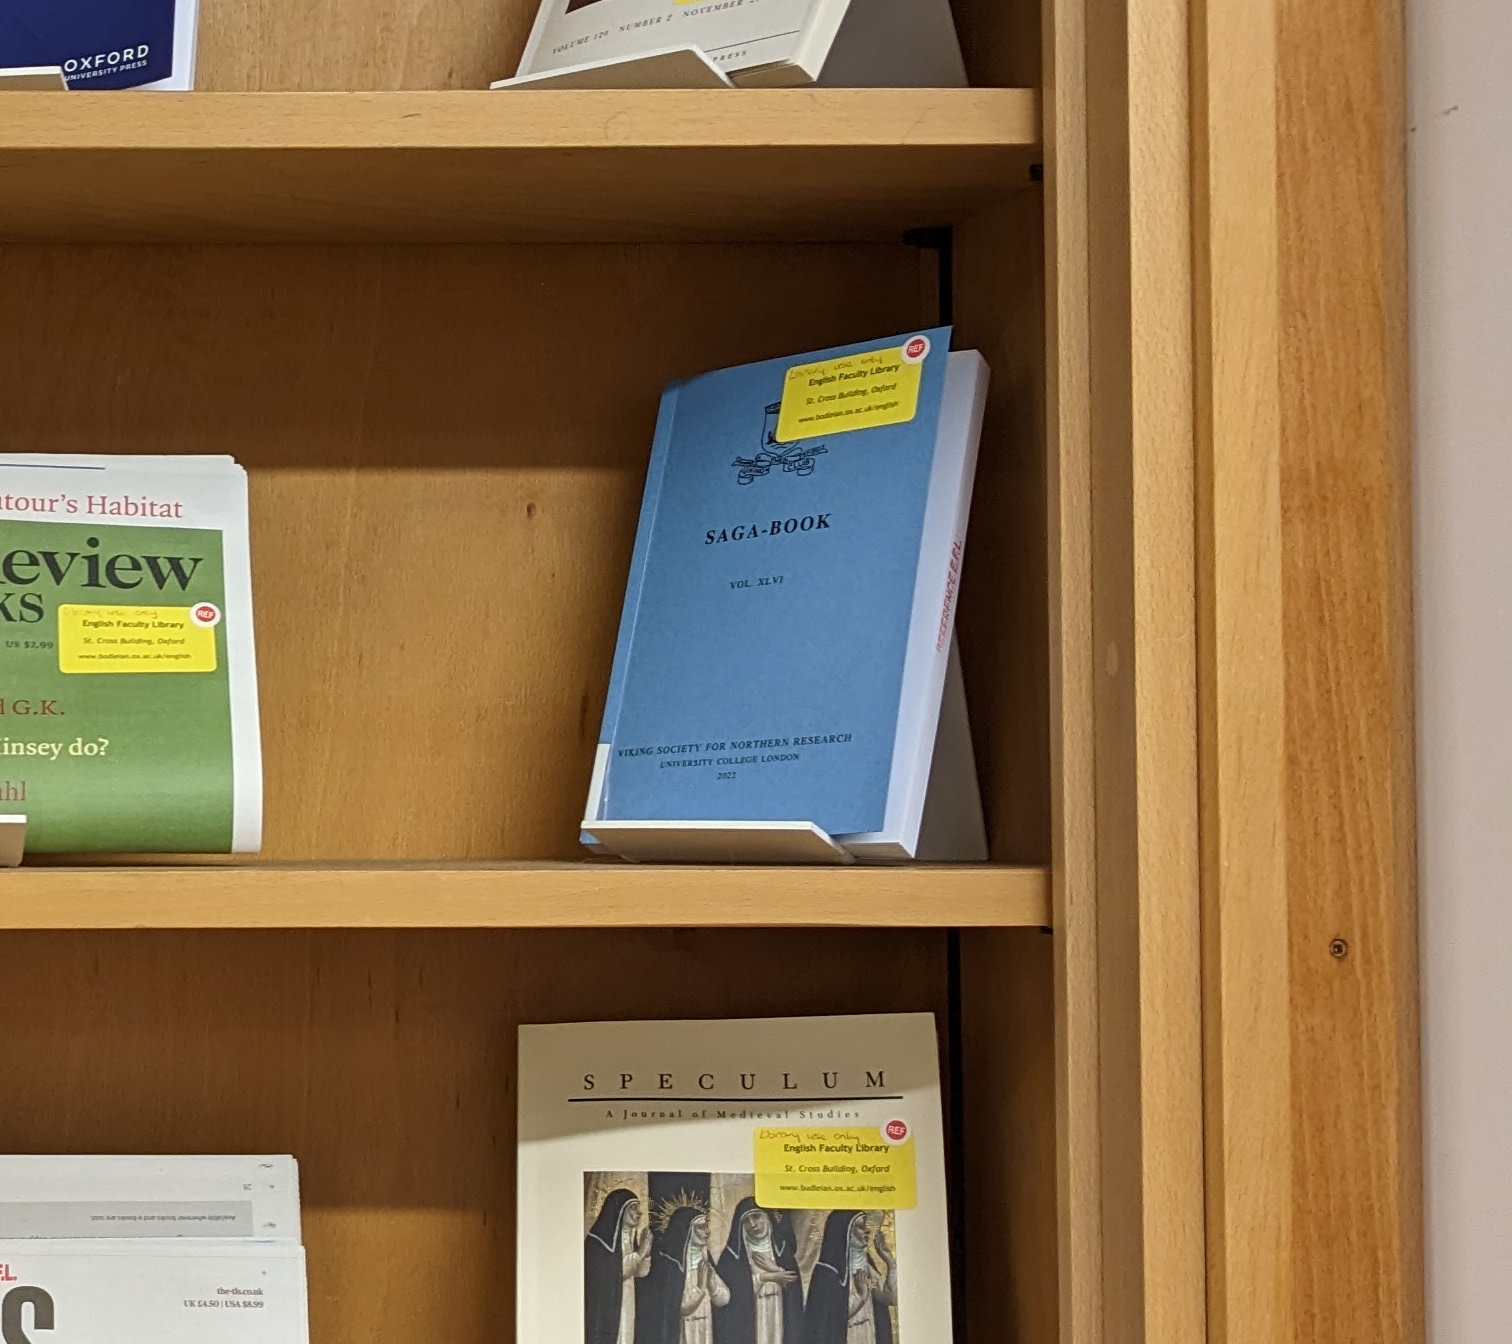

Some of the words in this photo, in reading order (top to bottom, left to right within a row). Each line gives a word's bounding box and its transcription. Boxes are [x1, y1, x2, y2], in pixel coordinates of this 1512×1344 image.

[552, 36, 590, 55] VOLUME
[619, 17, 662, 33] NUMBER
[666, 14, 673, 22] 2
[683, 0, 744, 17] NOVEMBER
[64, 44, 150, 73] OXFORD
[86, 493, 183, 518] Habitat
[704, 513, 832, 545] SAGA-BOOK
[758, 575, 784, 587] XLVI
[12, 697, 64, 716] G.K.
[68, 737, 109, 756] do?
[618, 746, 653, 758] VIKING
[657, 743, 701, 755] SOCIETY
[705, 741, 726, 752] FOR
[730, 736, 789, 751] NORTHERN
[793, 733, 852, 746] RESEARCH
[583, 1071, 887, 1091] SPECULUM
[606, 1110, 614, 1118] A
[624, 1110, 683, 1118] Journal
[692, 1110, 707, 1118] of
[717, 1110, 790, 1118] Medieval
[799, 1110, 860, 1118] Studies
[784, 1144, 816, 1154] English
[819, 1144, 853, 1154] Faculty
[856, 1143, 889, 1154] Library
